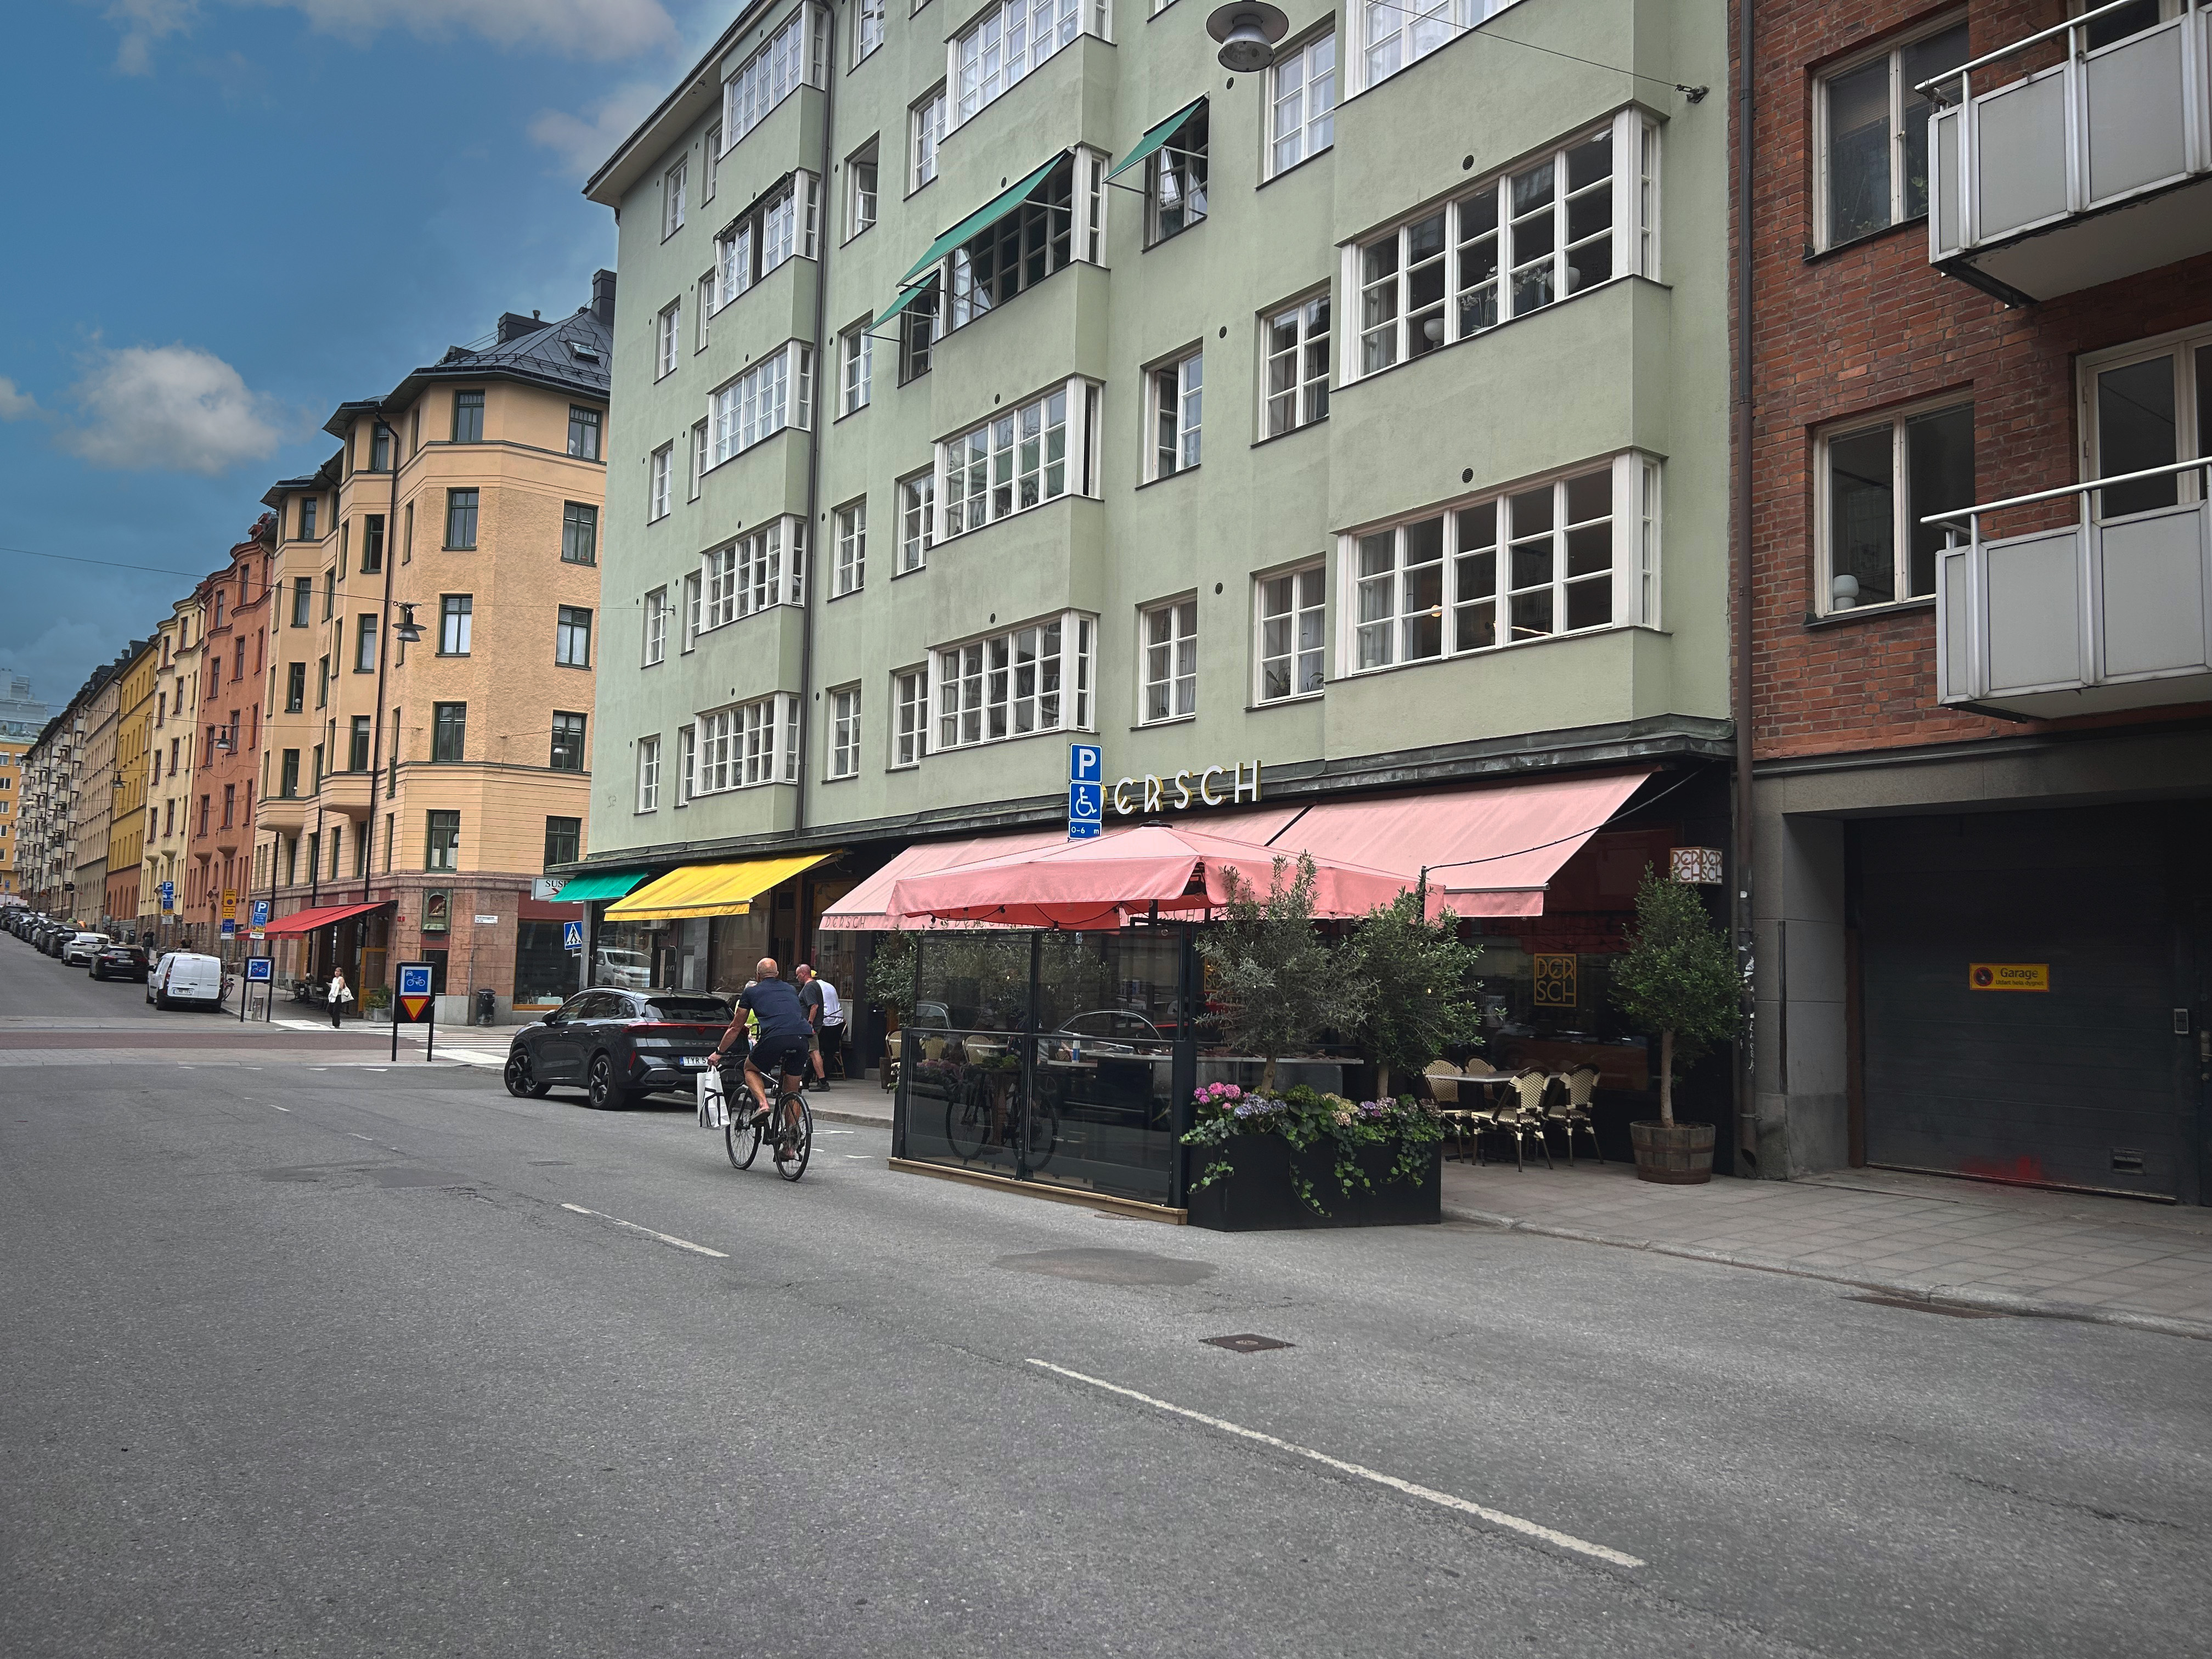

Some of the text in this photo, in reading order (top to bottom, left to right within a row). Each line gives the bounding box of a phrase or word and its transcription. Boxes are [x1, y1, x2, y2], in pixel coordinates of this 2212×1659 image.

[1079, 748, 1096, 778] P
[1102, 760, 1261, 815] ERSCH
[1673, 866, 1701, 881] CH
[257, 902, 267, 912] P
[825, 916, 866, 928] DERSCH
[1537, 958, 1574, 979] DER
[2000, 967, 2039, 980] Garage
[1537, 980, 1576, 1002] SCH
